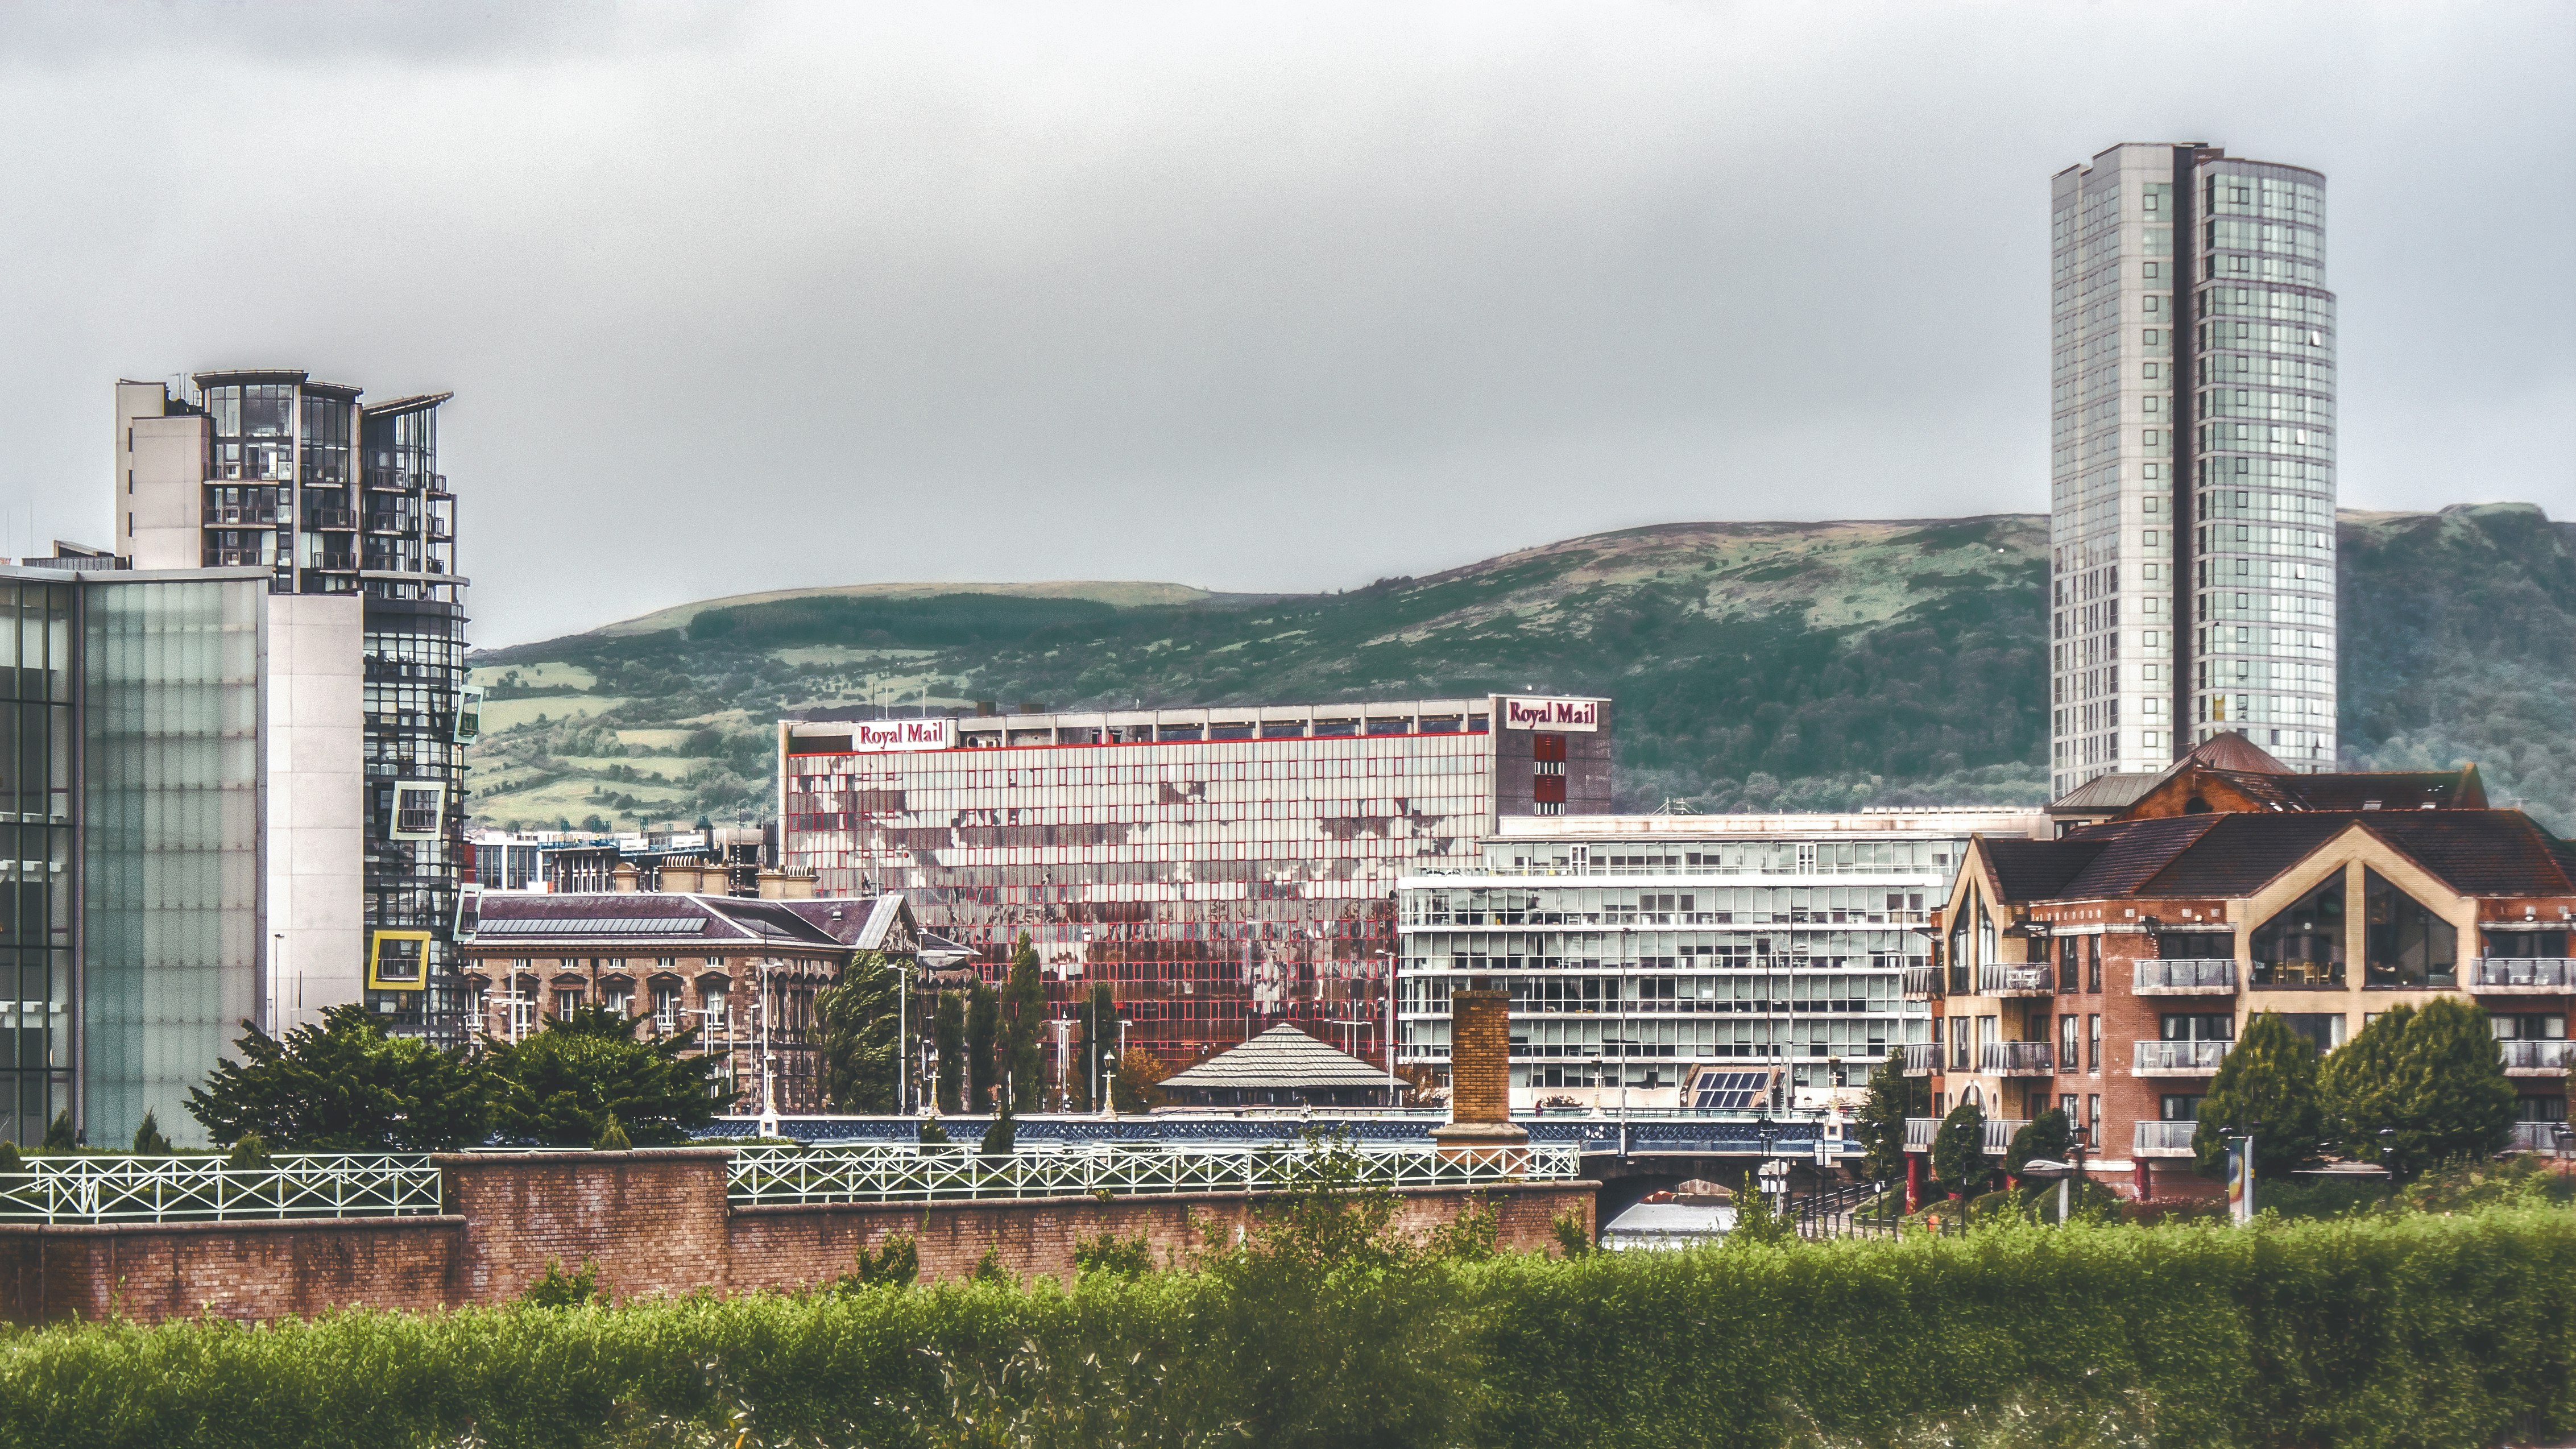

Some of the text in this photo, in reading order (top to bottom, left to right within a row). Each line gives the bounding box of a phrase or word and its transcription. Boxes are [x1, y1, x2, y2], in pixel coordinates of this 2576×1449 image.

[1510, 701, 1595, 729] Royal Mail
[859, 721, 943, 750] Royal Mail
